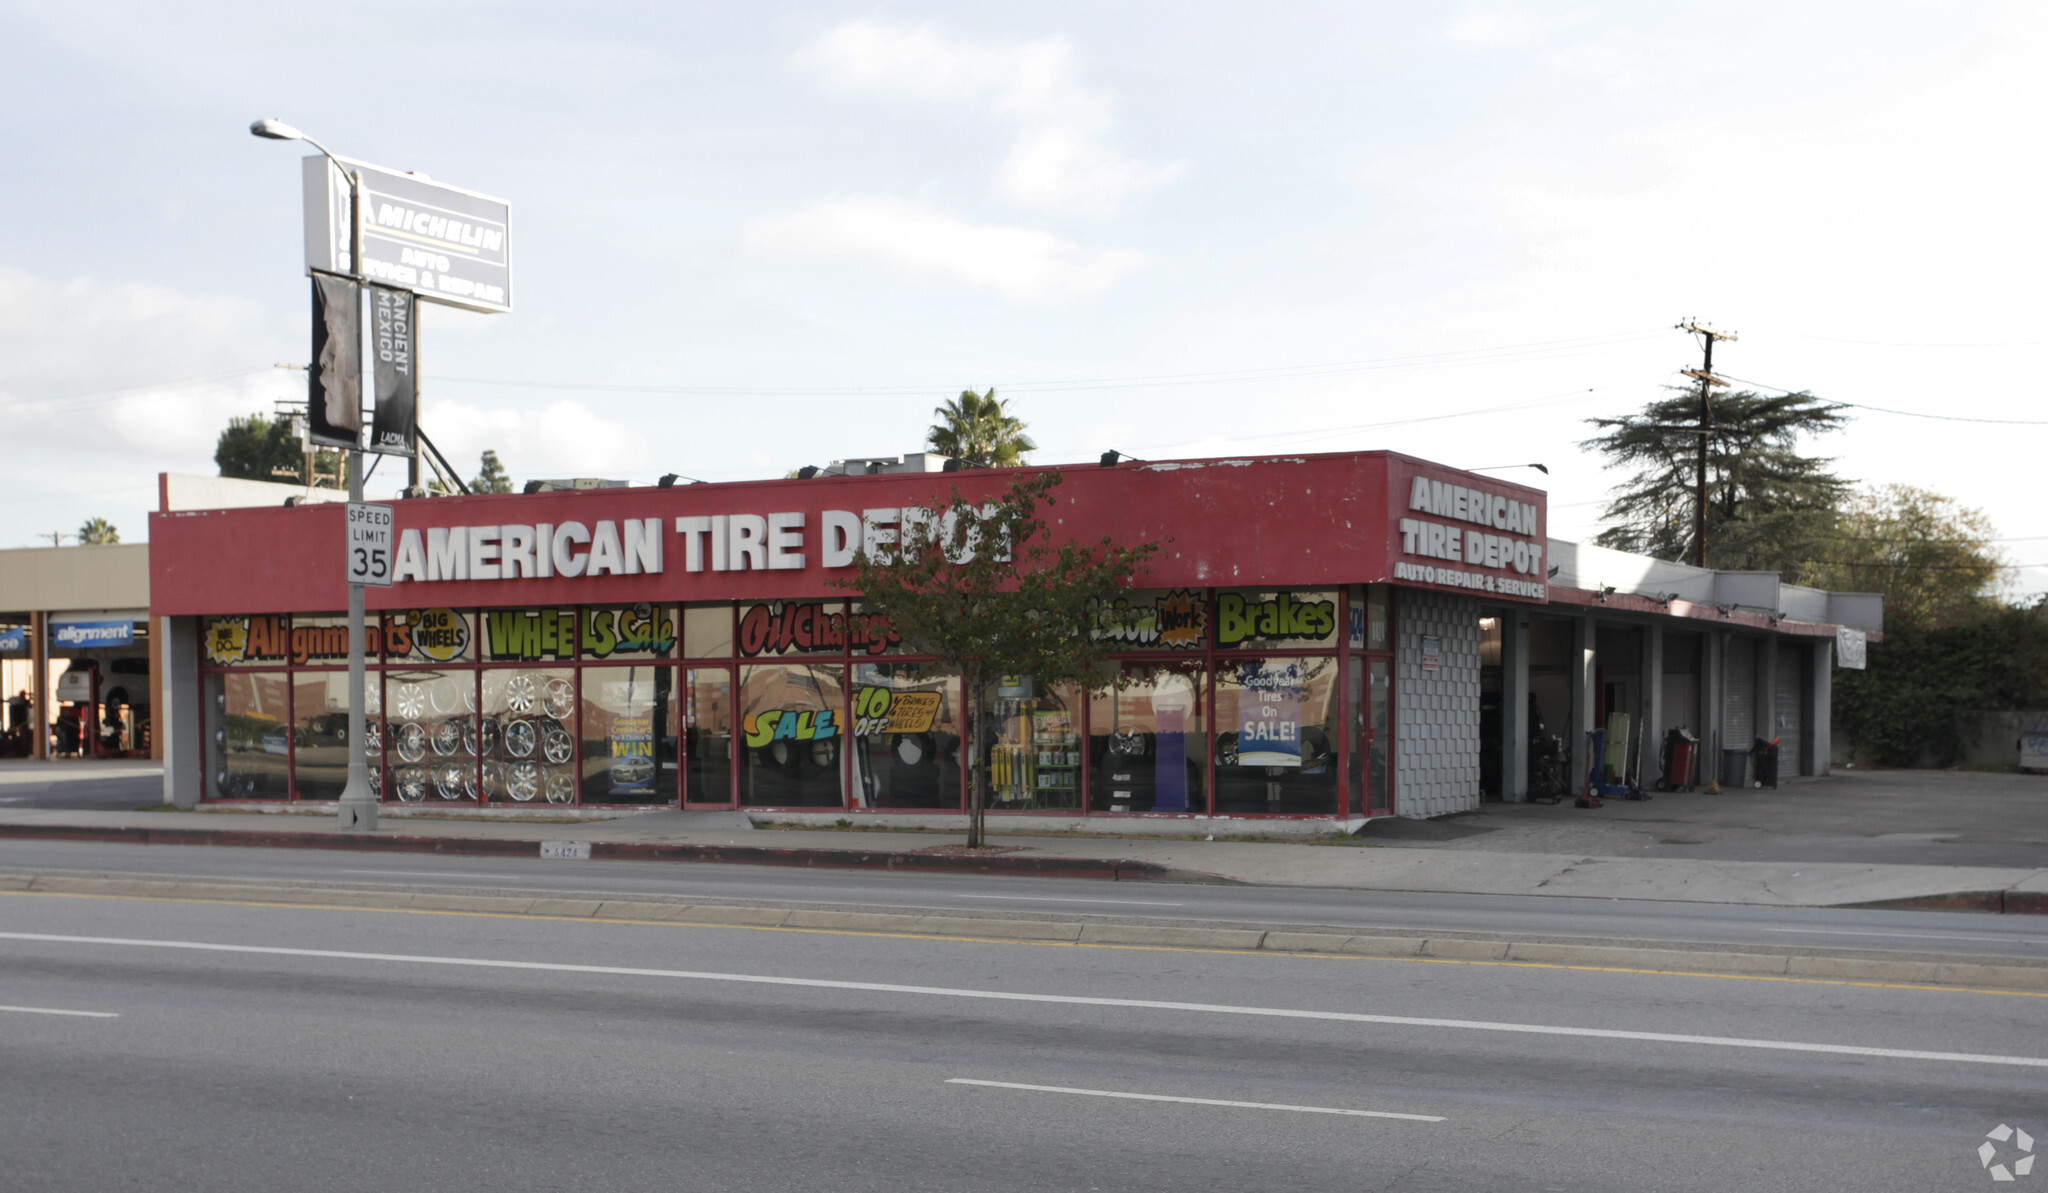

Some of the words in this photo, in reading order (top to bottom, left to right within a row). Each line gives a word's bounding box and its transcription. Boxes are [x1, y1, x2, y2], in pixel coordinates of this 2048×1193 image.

[378, 203, 503, 252] MICHELIN
[401, 247, 450, 273] AUTO
[338, 252, 417, 285] SRVICE
[420, 271, 435, 289] &
[438, 274, 504, 303] REPAIR
[378, 292, 393, 362] MEXICO
[393, 294, 408, 376] ANCIENT
[380, 431, 405, 446] LACMA
[349, 509, 390, 526] SPEED
[1409, 476, 1537, 537] AMERICAN
[353, 529, 386, 544] LIMIT
[392, 517, 664, 583] AMERICAN
[675, 512, 806, 573] TIRE
[821, 503, 1022, 568] DEPOT
[1400, 518, 1462, 562] TIRE
[1463, 530, 1542, 576] DEPOT
[353, 548, 387, 577] 35
[1394, 562, 1435, 583] AUTO
[1435, 568, 1485, 590] REPAIR
[1486, 576, 1495, 592] &
[1496, 577, 1545, 598] SERVICE
[423, 613, 448, 628] BIG
[487, 605, 616, 659] WHEELS
[613, 602, 677, 655] Sale
[740, 600, 796, 657] Oil
[1160, 603, 1202, 632] Work
[1218, 593, 1335, 645] Brakes
[57, 624, 128, 643] alignment
[247, 615, 412, 664] Alignmnts
[417, 628, 465, 648] WHEELS
[1245, 675, 1294, 688] Goodyear
[1258, 690, 1282, 702] Tires
[1262, 705, 1277, 717] On
[746, 709, 838, 748] SALE
[854, 717, 889, 737] OFF
[1244, 721, 1296, 741] SALE!
[612, 741, 652, 757] WIN
